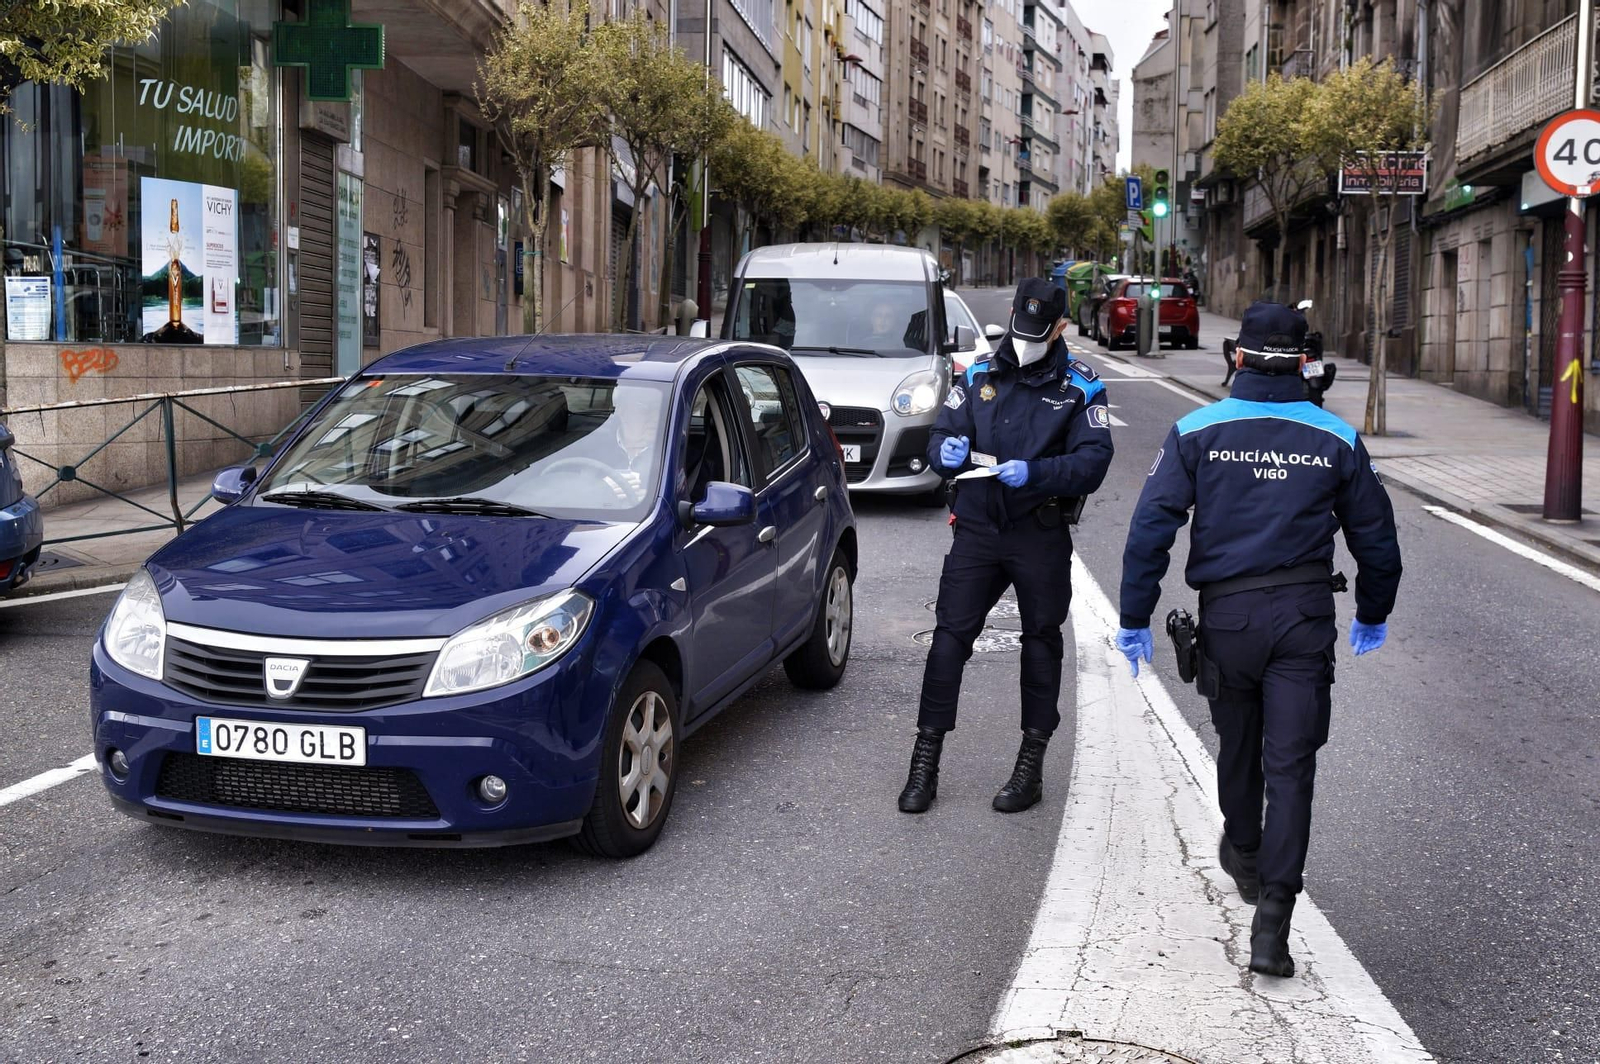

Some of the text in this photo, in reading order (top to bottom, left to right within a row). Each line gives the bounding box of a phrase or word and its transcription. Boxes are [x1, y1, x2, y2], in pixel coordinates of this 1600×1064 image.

[139, 79, 237, 122] TU SALUD
[173, 125, 247, 164] IMPORTA
[1553, 138, 1600, 165] 40
[1129, 182, 1138, 206] P
[206, 200, 232, 216] VICHY
[1209, 449, 1333, 468] POLICÍA LOCAL
[1253, 468, 1288, 480] VIGO
[202, 740, 209, 748] E
[216, 723, 355, 760] 0780 GLB
